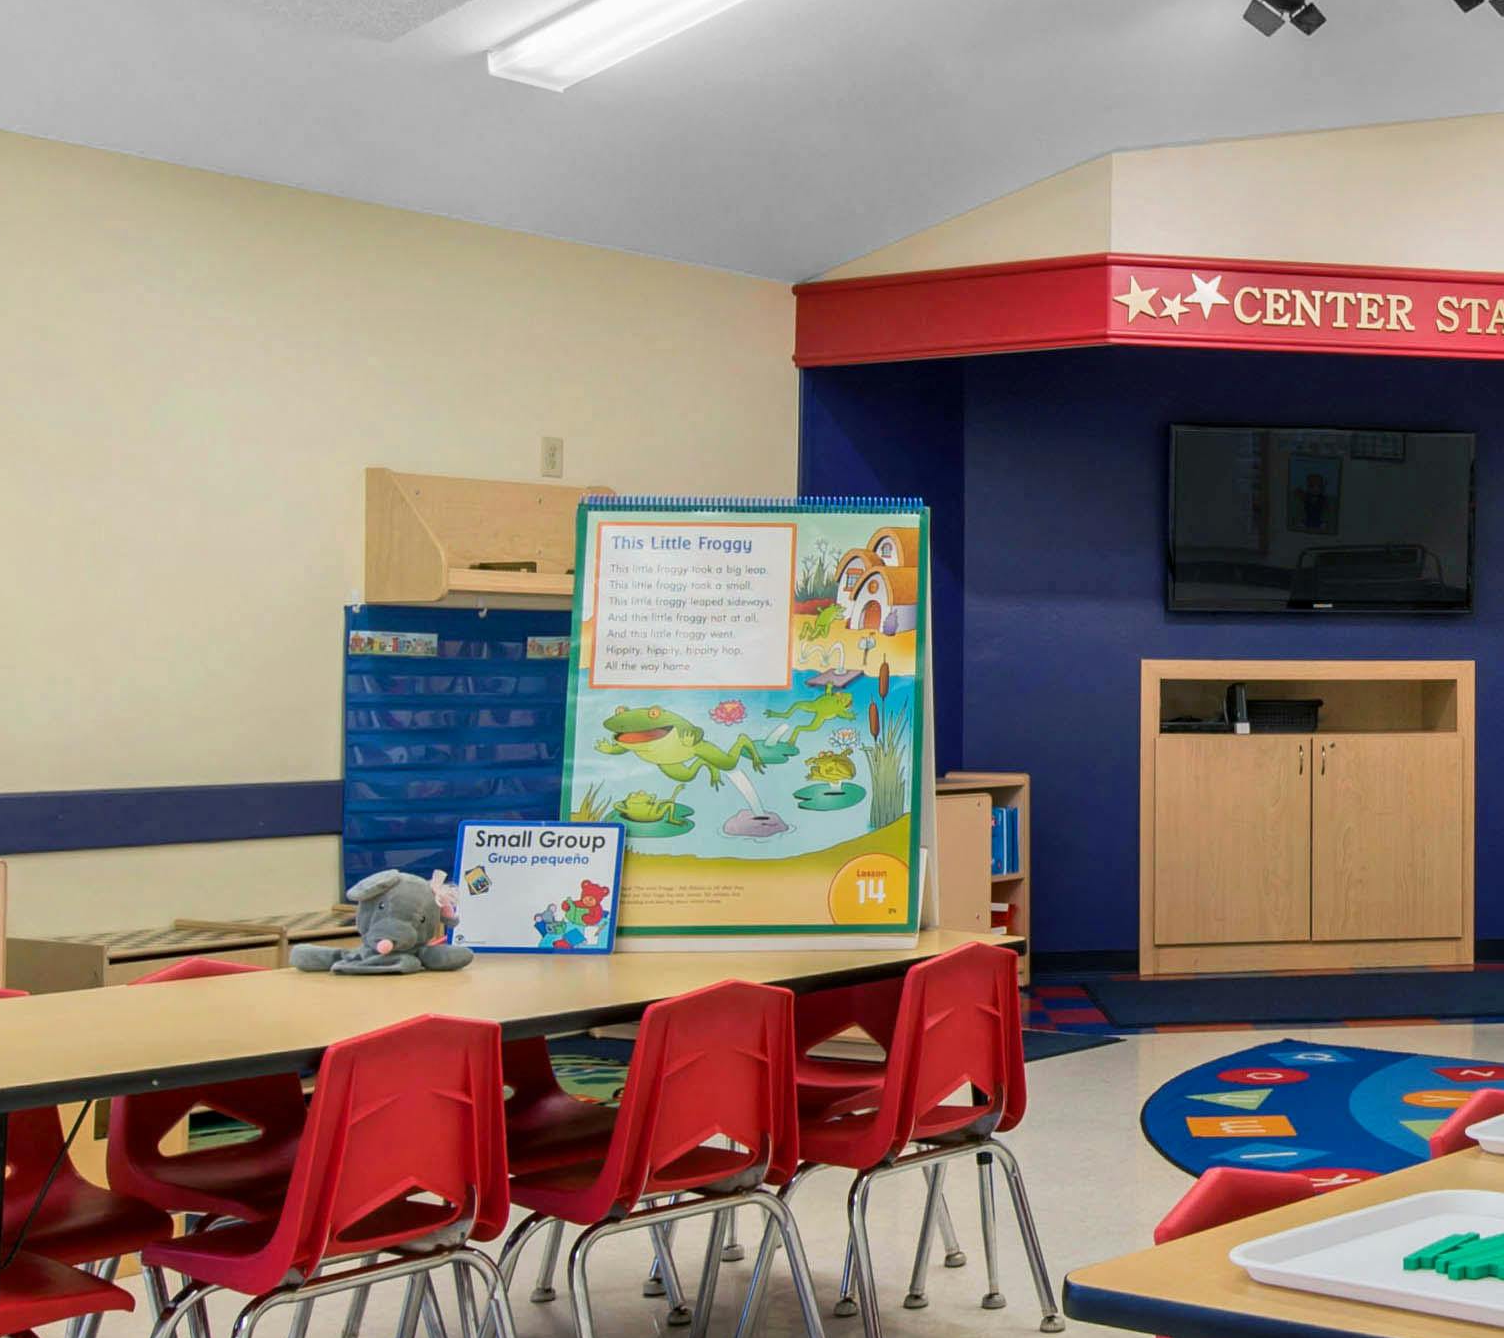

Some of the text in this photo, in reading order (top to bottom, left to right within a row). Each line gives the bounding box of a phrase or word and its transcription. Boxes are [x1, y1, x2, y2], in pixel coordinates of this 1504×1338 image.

[1233, 286, 1415, 332] CENTER
[611, 536, 753, 553] This Little Froggy
[726, 565, 741, 575] big
[691, 597, 723, 608] leaped
[608, 613, 627, 621] And
[632, 613, 647, 621] this
[651, 613, 672, 621] little
[677, 613, 706, 624] froggy
[711, 613, 726, 621] not
[607, 629, 627, 638] And
[631, 629, 647, 638] this
[605, 661, 618, 670] All
[621, 661, 636, 670] the
[640, 664, 659, 672] way
[475, 830, 606, 852] Small Group
[488, 852, 589, 866] Grupo pequeño
[856, 869, 887, 878] Lesson
[856, 878, 887, 904] 14
